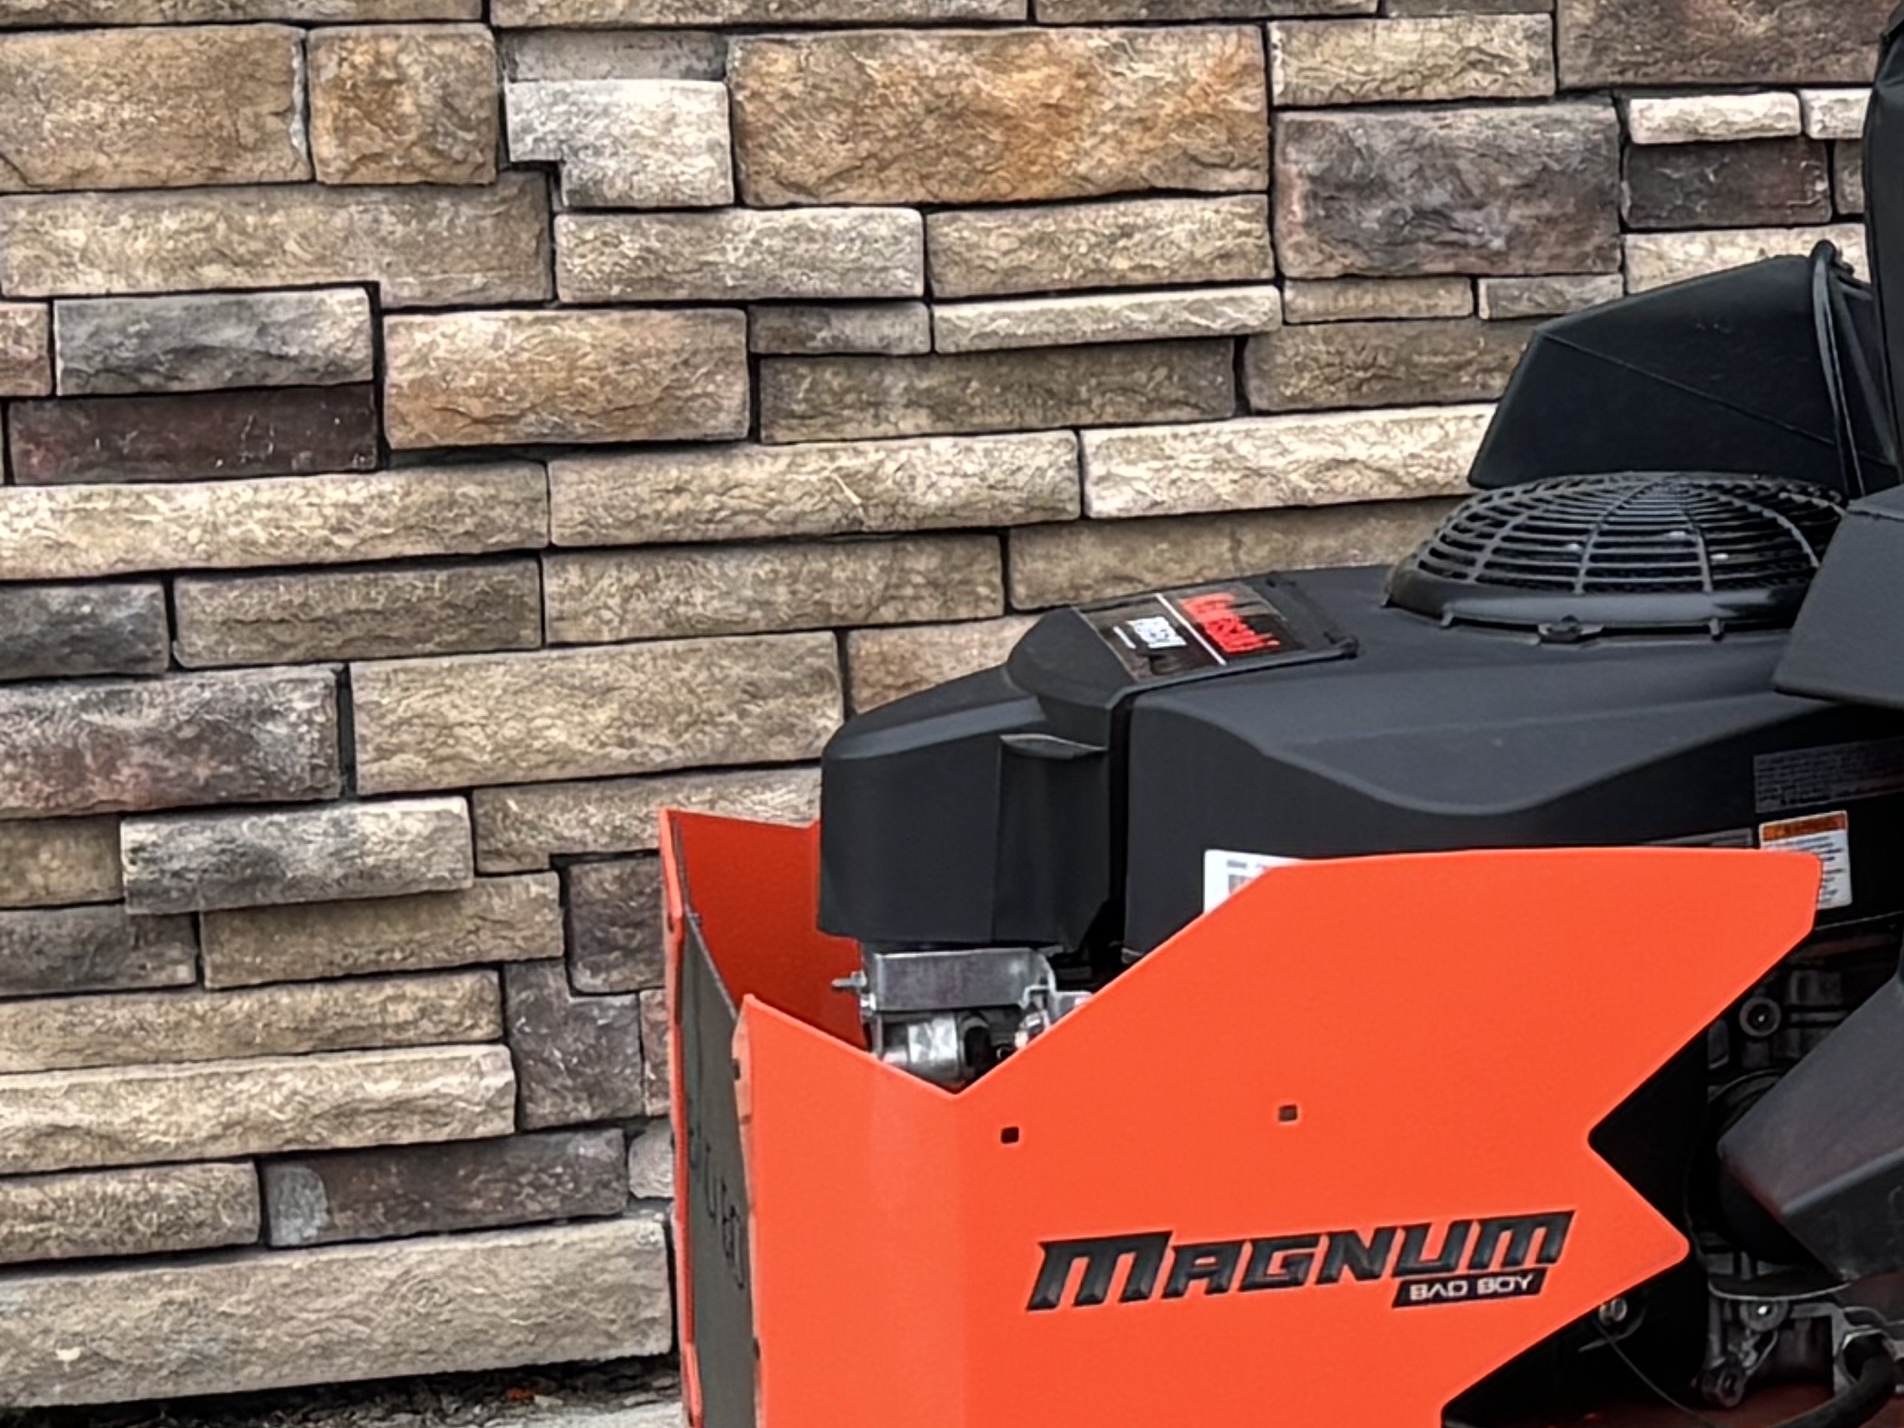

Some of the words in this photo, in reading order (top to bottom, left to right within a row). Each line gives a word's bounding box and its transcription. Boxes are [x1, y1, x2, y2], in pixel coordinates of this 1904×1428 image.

[1025, 1209, 1576, 1312] MAGNUM
[1410, 1281, 1468, 1301] BAD
[1477, 1274, 1534, 1295] BOY
